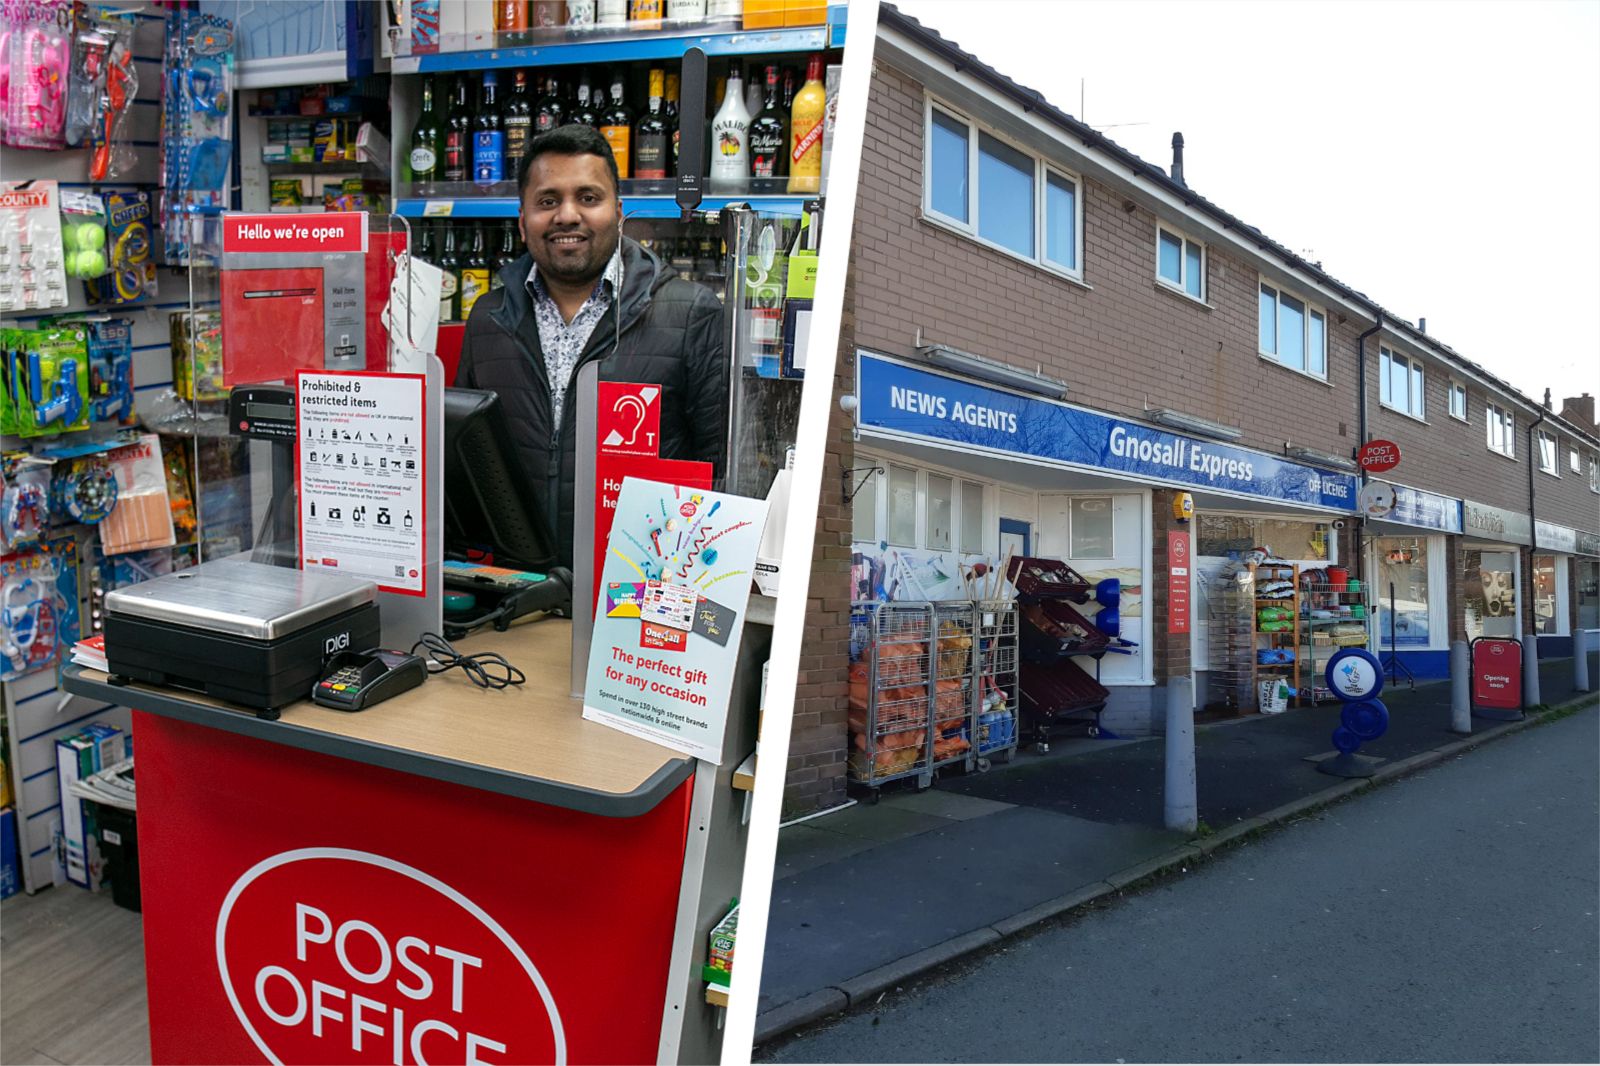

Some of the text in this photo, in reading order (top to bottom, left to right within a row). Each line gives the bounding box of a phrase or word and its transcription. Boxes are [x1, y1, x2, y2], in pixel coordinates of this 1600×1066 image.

[238, 224, 344, 242] Hello we're open
[302, 380, 361, 392] Prohibited &
[302, 395, 377, 408] restricted items
[891, 386, 1017, 433] NEWS AGENTS
[646, 433, 655, 446] T
[1110, 426, 1252, 481] Gnosall Express
[1362, 454, 1395, 465] OFFICE
[1367, 446, 1390, 455] POST
[604, 478, 622, 491] Ho
[1308, 479, 1348, 498] OFF LICENSE
[326, 632, 350, 654] DIGI
[612, 647, 707, 685] The perfect gift
[606, 666, 707, 706] for any occasion
[1484, 674, 1509, 683] Opening
[599, 690, 617, 700] Spend
[625, 698, 638, 707] over
[652, 706, 665, 716] high
[667, 711, 685, 722] street
[686, 717, 708, 728] brands
[621, 707, 654, 722] nationwide
[661, 719, 680, 730] online
[296, 902, 482, 1013] POST
[254, 965, 506, 1066] OFFICE
